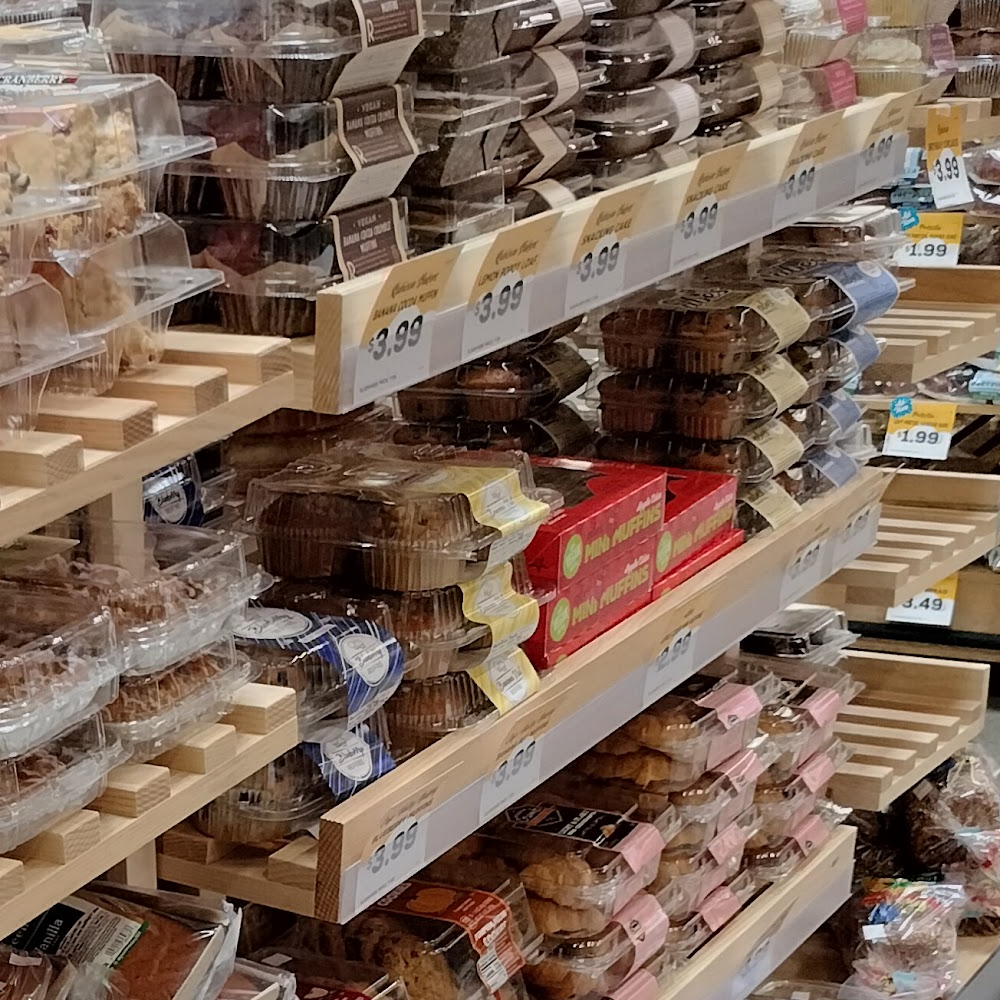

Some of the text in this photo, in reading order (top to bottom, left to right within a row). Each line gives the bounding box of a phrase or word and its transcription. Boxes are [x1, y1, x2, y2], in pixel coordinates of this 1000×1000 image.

[474, 280, 524, 323] $3.99
[367, 315, 423, 361] $3.99
[612, 502, 661, 547] MUFFINS
[599, 564, 649, 609] MUFFINS
